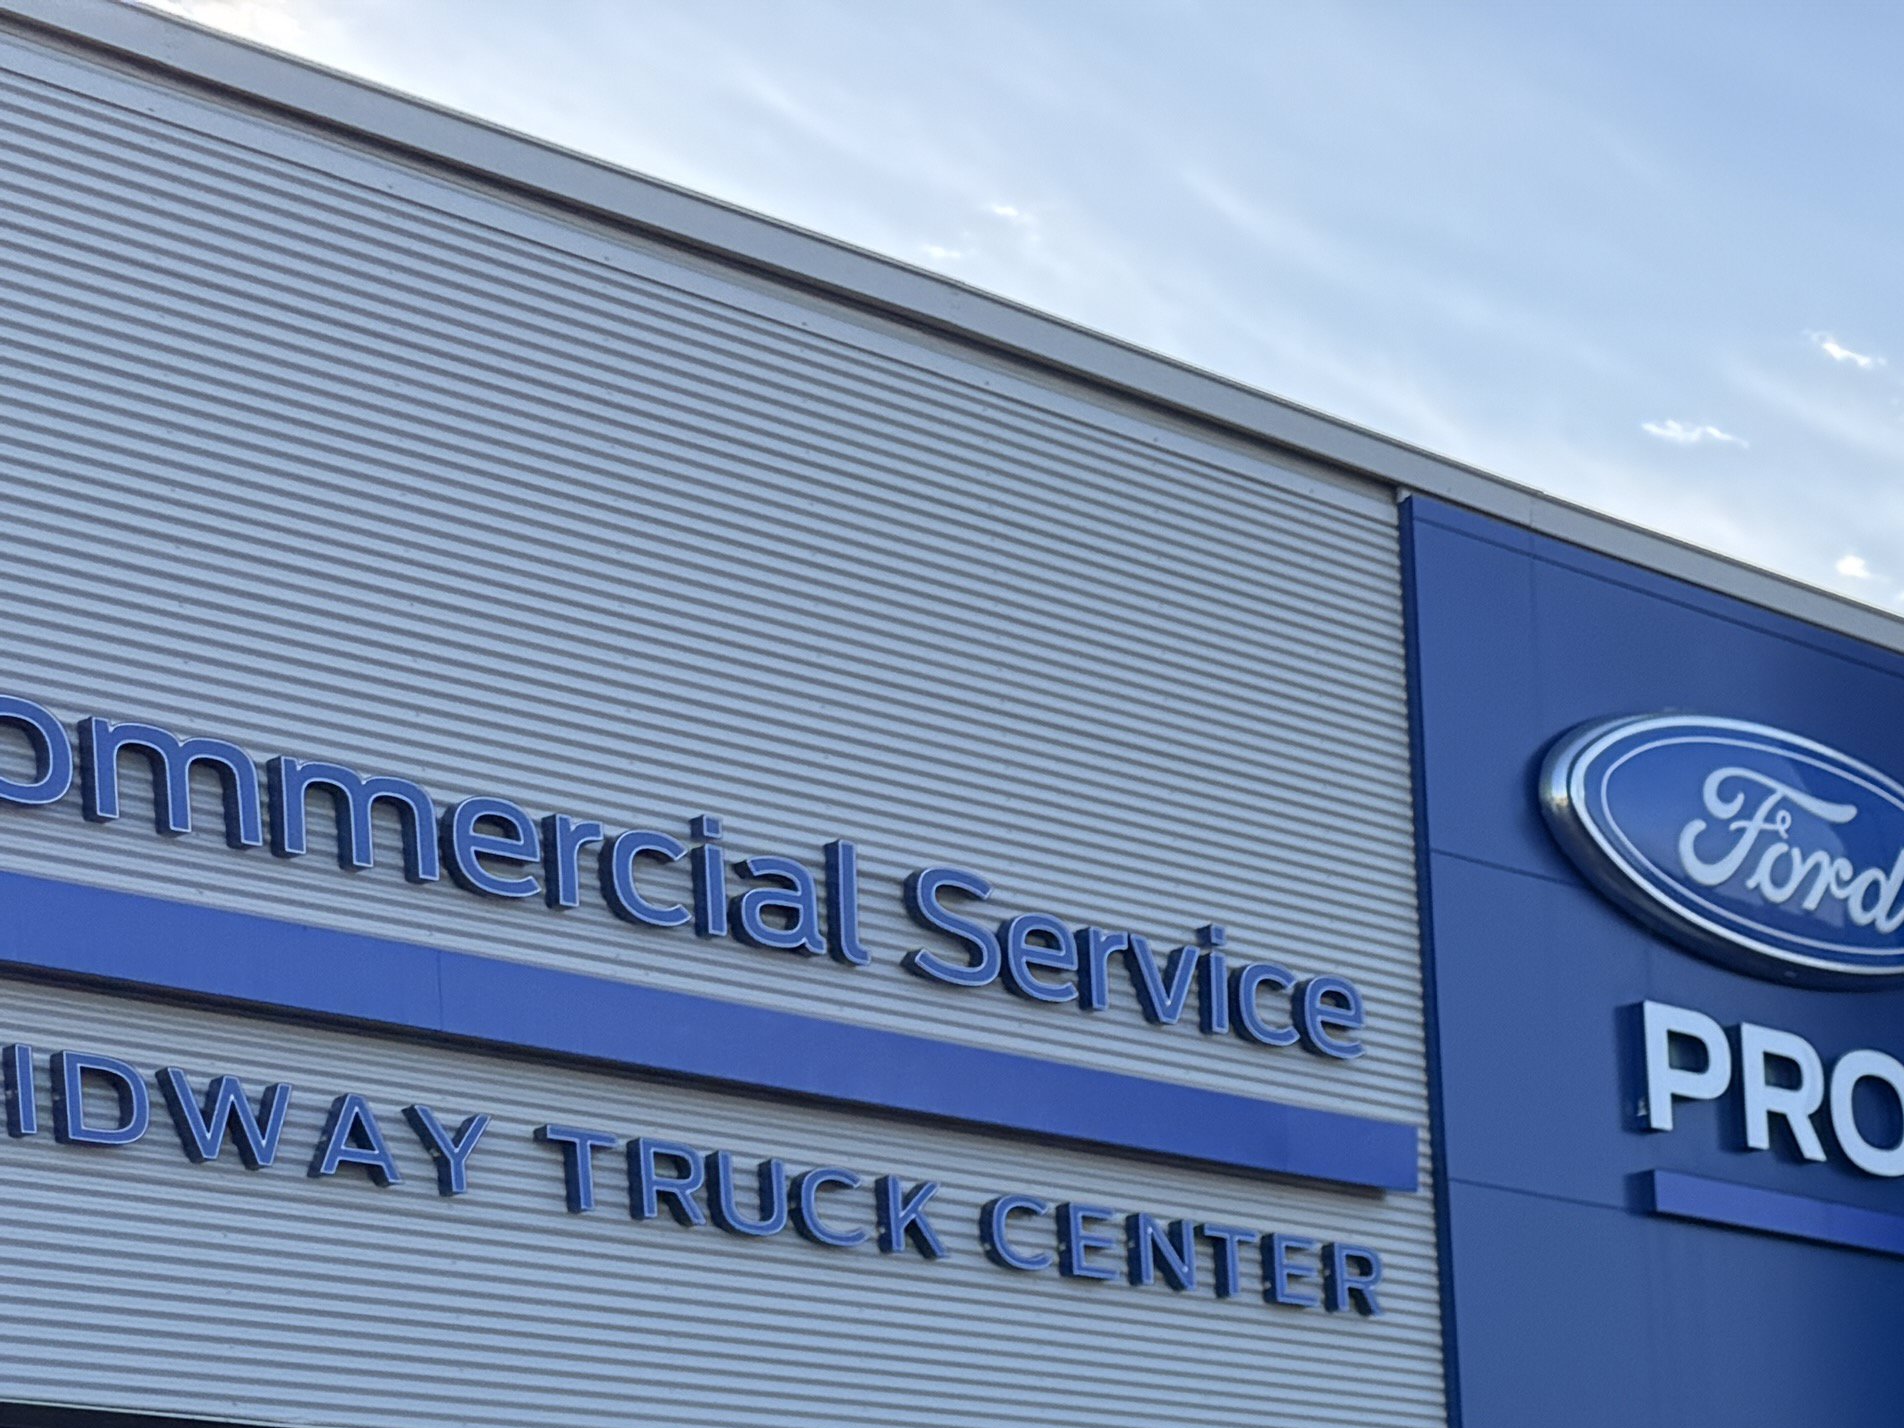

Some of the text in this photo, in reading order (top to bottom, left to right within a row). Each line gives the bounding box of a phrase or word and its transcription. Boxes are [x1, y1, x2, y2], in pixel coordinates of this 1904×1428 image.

[904, 865, 1366, 1060] Service
[2, 1043, 1383, 1316] IDWAY TRUCK CENTER
